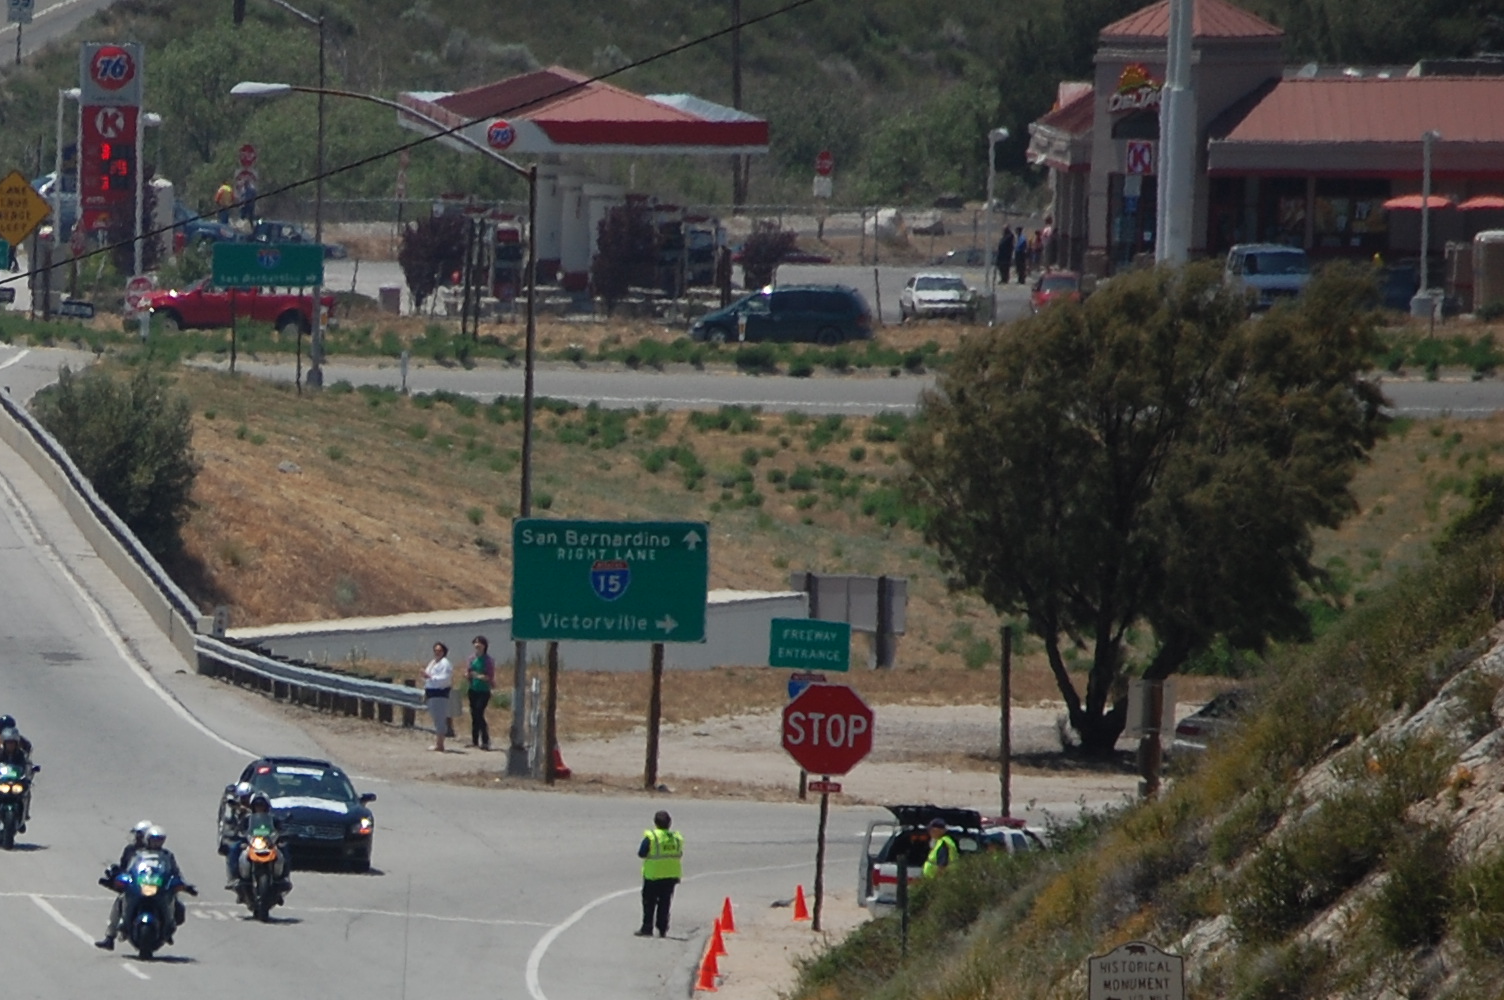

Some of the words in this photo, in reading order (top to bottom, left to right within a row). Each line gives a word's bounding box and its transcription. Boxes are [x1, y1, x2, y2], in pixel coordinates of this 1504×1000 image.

[98, 56, 127, 80] 76
[522, 529, 557, 545] San
[565, 529, 671, 547] Bernardino
[557, 548, 607, 560] RIGHT
[615, 549, 656, 561] LANE
[598, 574, 621, 593] 15
[539, 613, 648, 630] Victorville
[782, 629, 837, 642] FREEWAY
[777, 647, 841, 662] ENTRANCE
[786, 711, 868, 748] STOP
[1100, 961, 1172, 974] HISTORICAL
[1103, 978, 1169, 991] MONUMENT
